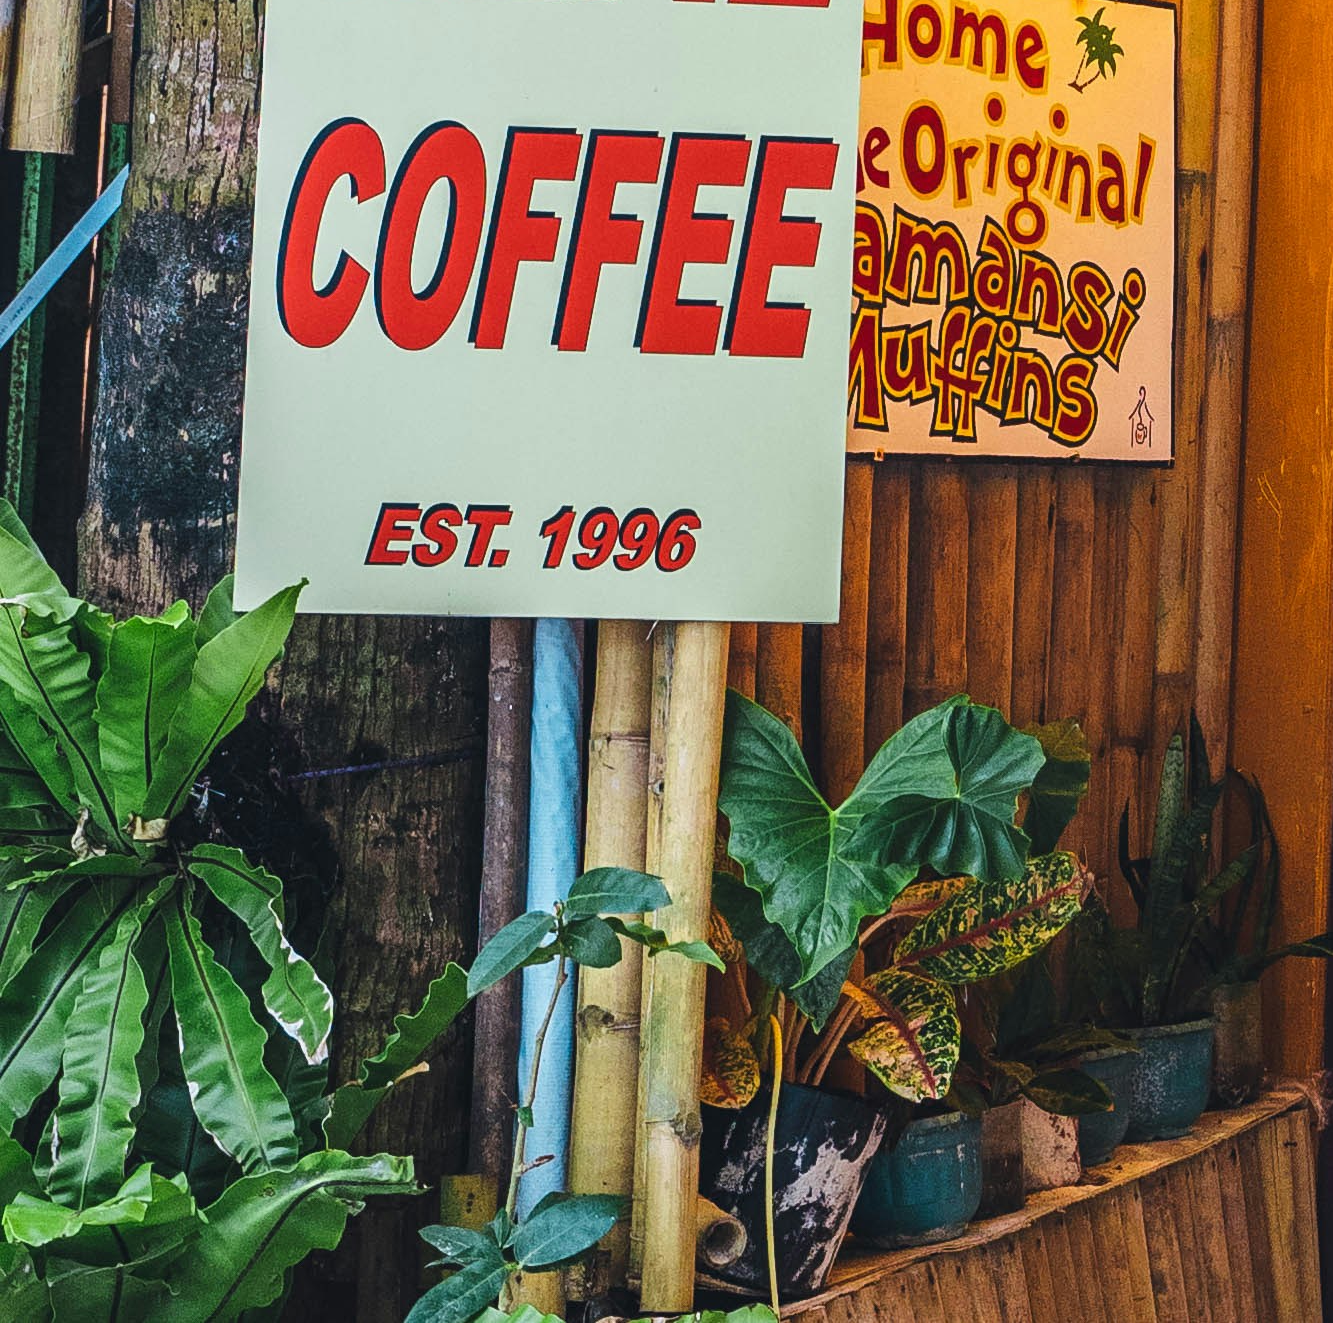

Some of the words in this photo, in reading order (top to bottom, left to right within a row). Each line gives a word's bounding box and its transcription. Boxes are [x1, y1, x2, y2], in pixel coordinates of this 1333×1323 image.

[276, 116, 840, 359] COFFEE
[901, 91, 1157, 251] Original
[852, 200, 1147, 372] amansi
[365, 502, 514, 568] EST.
[539, 505, 700, 572] 1996
